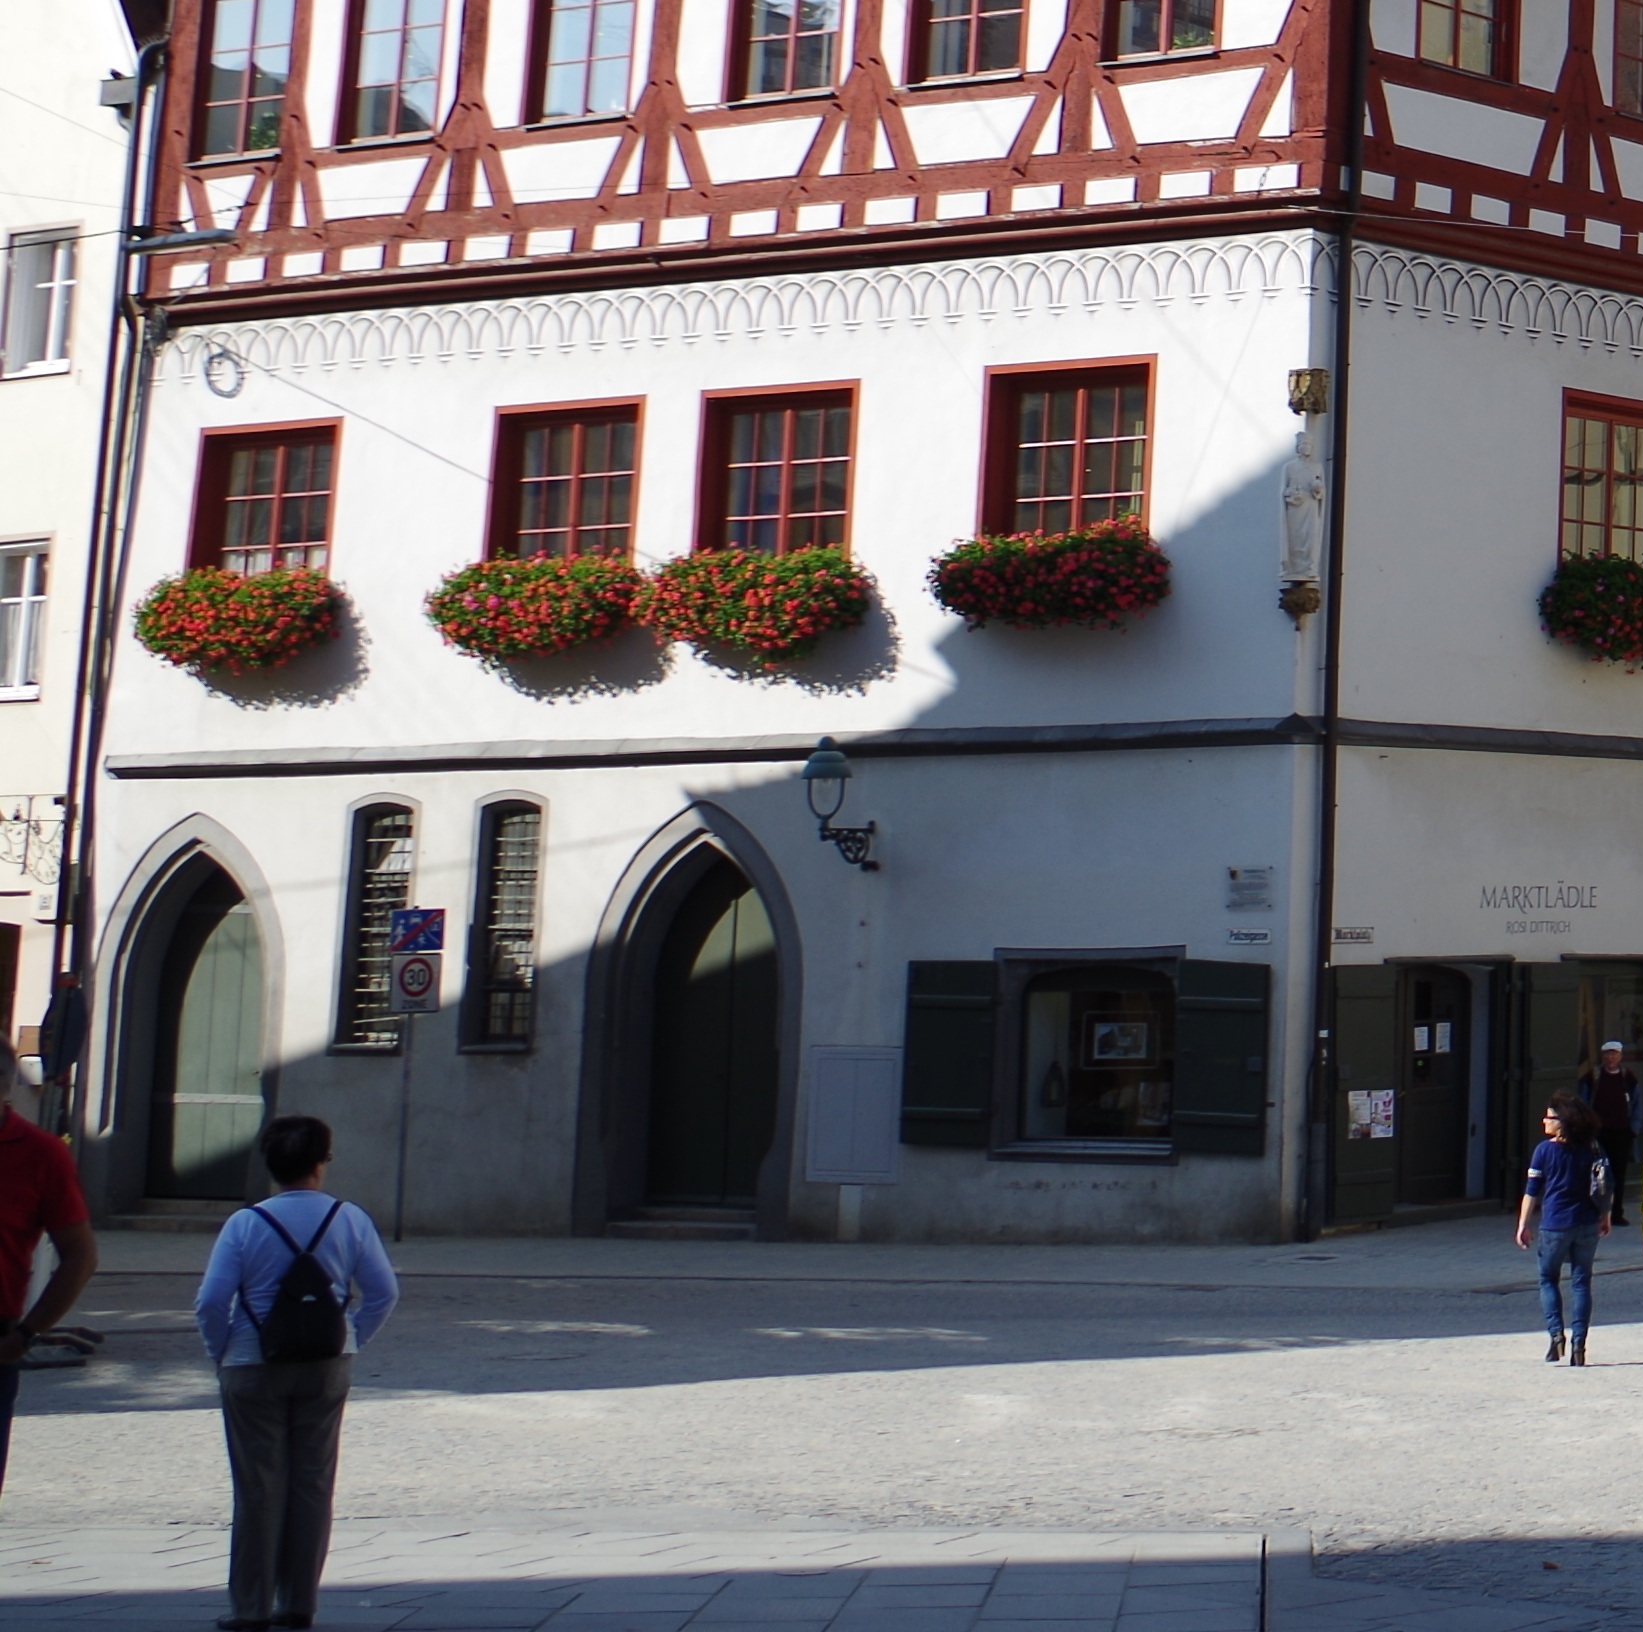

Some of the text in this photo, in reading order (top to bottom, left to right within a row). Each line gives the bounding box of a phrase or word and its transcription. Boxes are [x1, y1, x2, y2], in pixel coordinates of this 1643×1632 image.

[1479, 880, 1598, 914] MARKTLÄDLE
[1505, 920, 1572, 934] ROSI DITTRICH
[407, 968, 426, 986] 30
[402, 999, 427, 1009] ZONE
